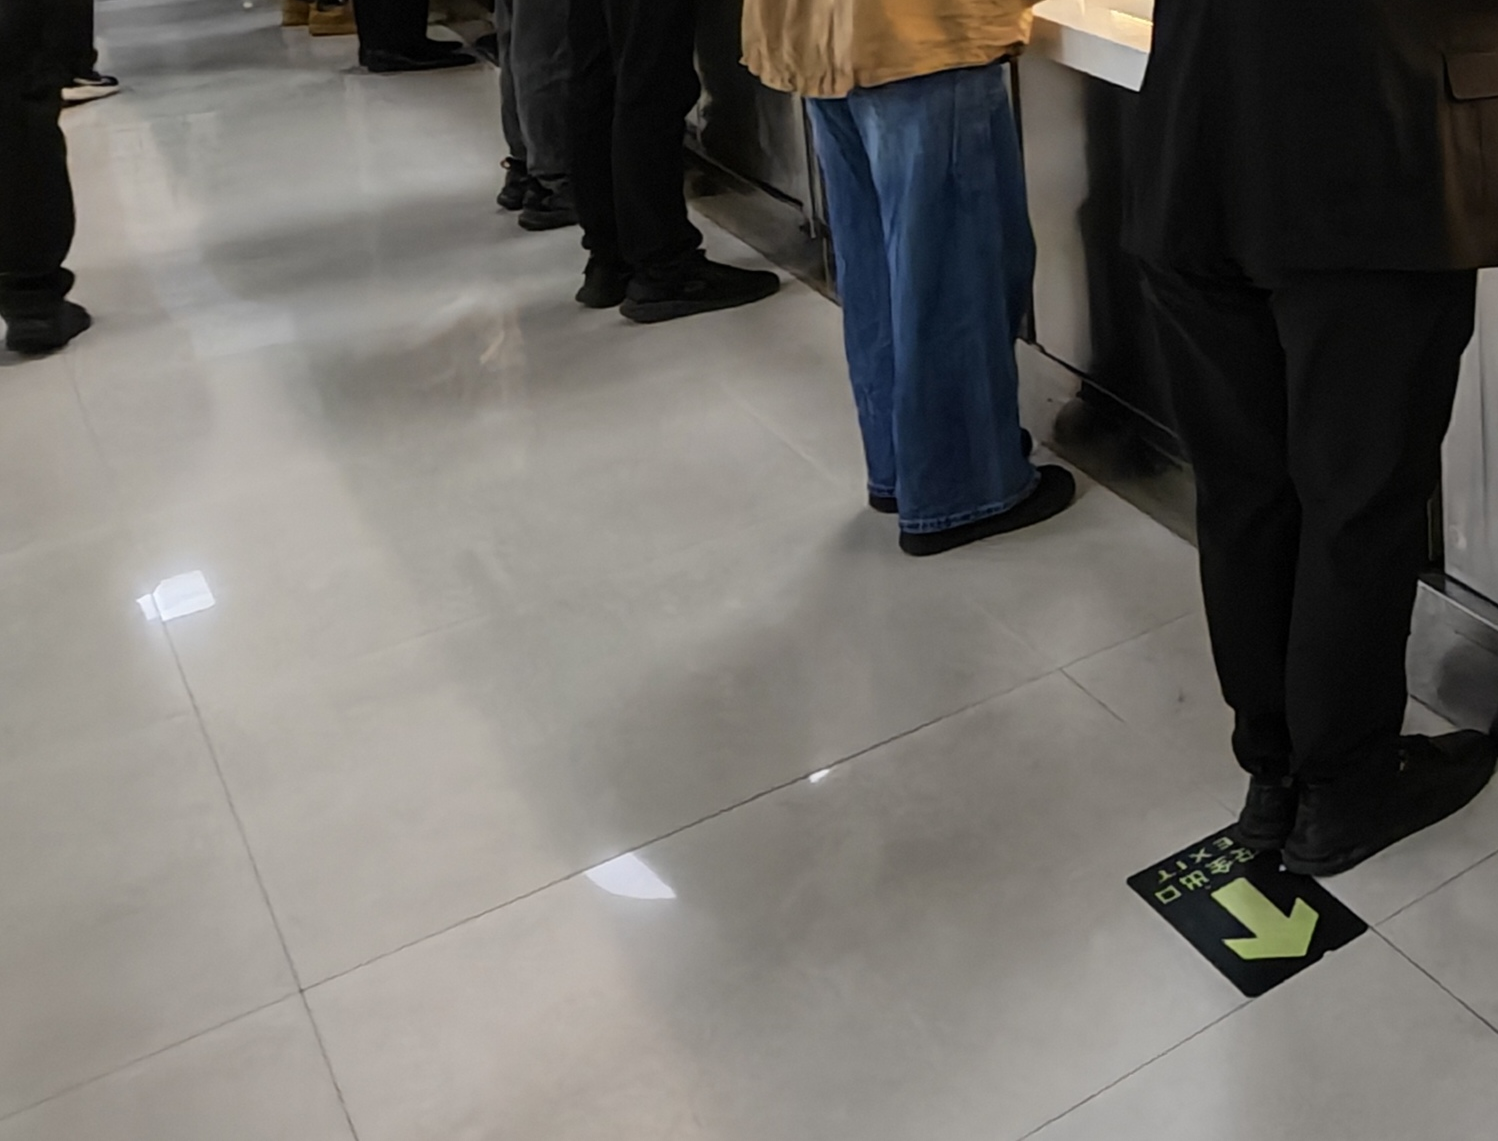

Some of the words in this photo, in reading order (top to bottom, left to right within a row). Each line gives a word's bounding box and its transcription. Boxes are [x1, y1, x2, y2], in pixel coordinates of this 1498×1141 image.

[1154, 846, 1255, 905] 安全出口
[1157, 836, 1234, 884] EXIT
